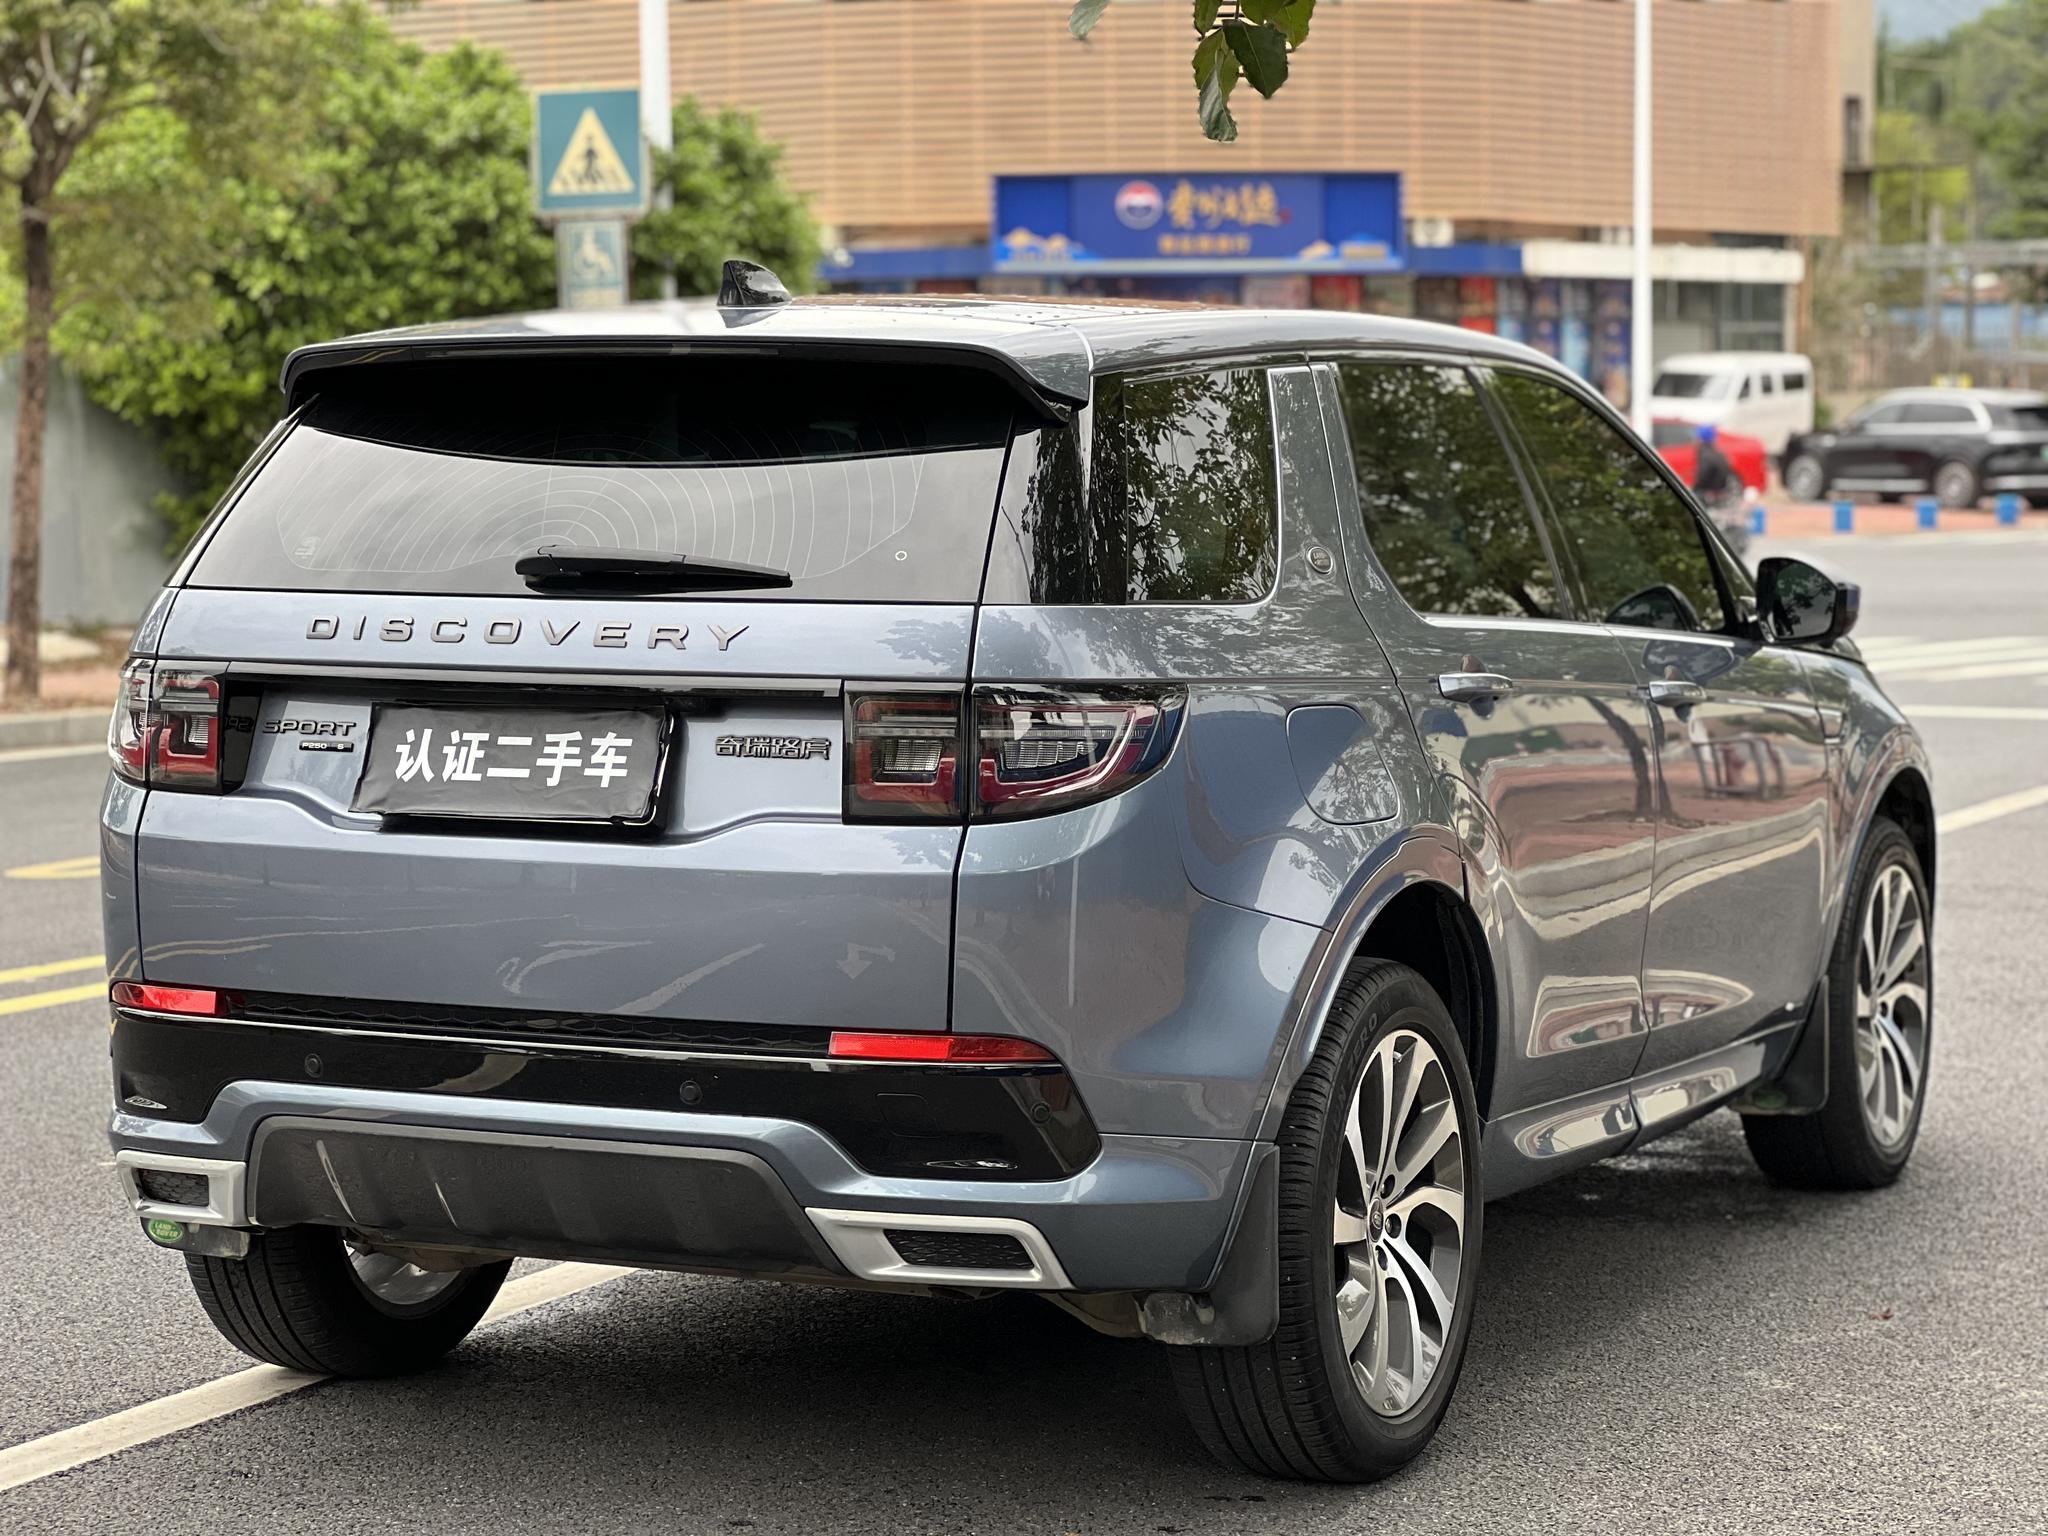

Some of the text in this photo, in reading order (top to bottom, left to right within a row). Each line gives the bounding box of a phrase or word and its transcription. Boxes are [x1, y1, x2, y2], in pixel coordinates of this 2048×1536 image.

[305, 615, 749, 651] DISCOVERY
[263, 720, 357, 736] SPORT
[302, 742, 328, 750] P250
[716, 735, 831, 760] 奇瑞路虎
[395, 728, 633, 788] 认证二手车
[154, 1221, 172, 1230] LAND
